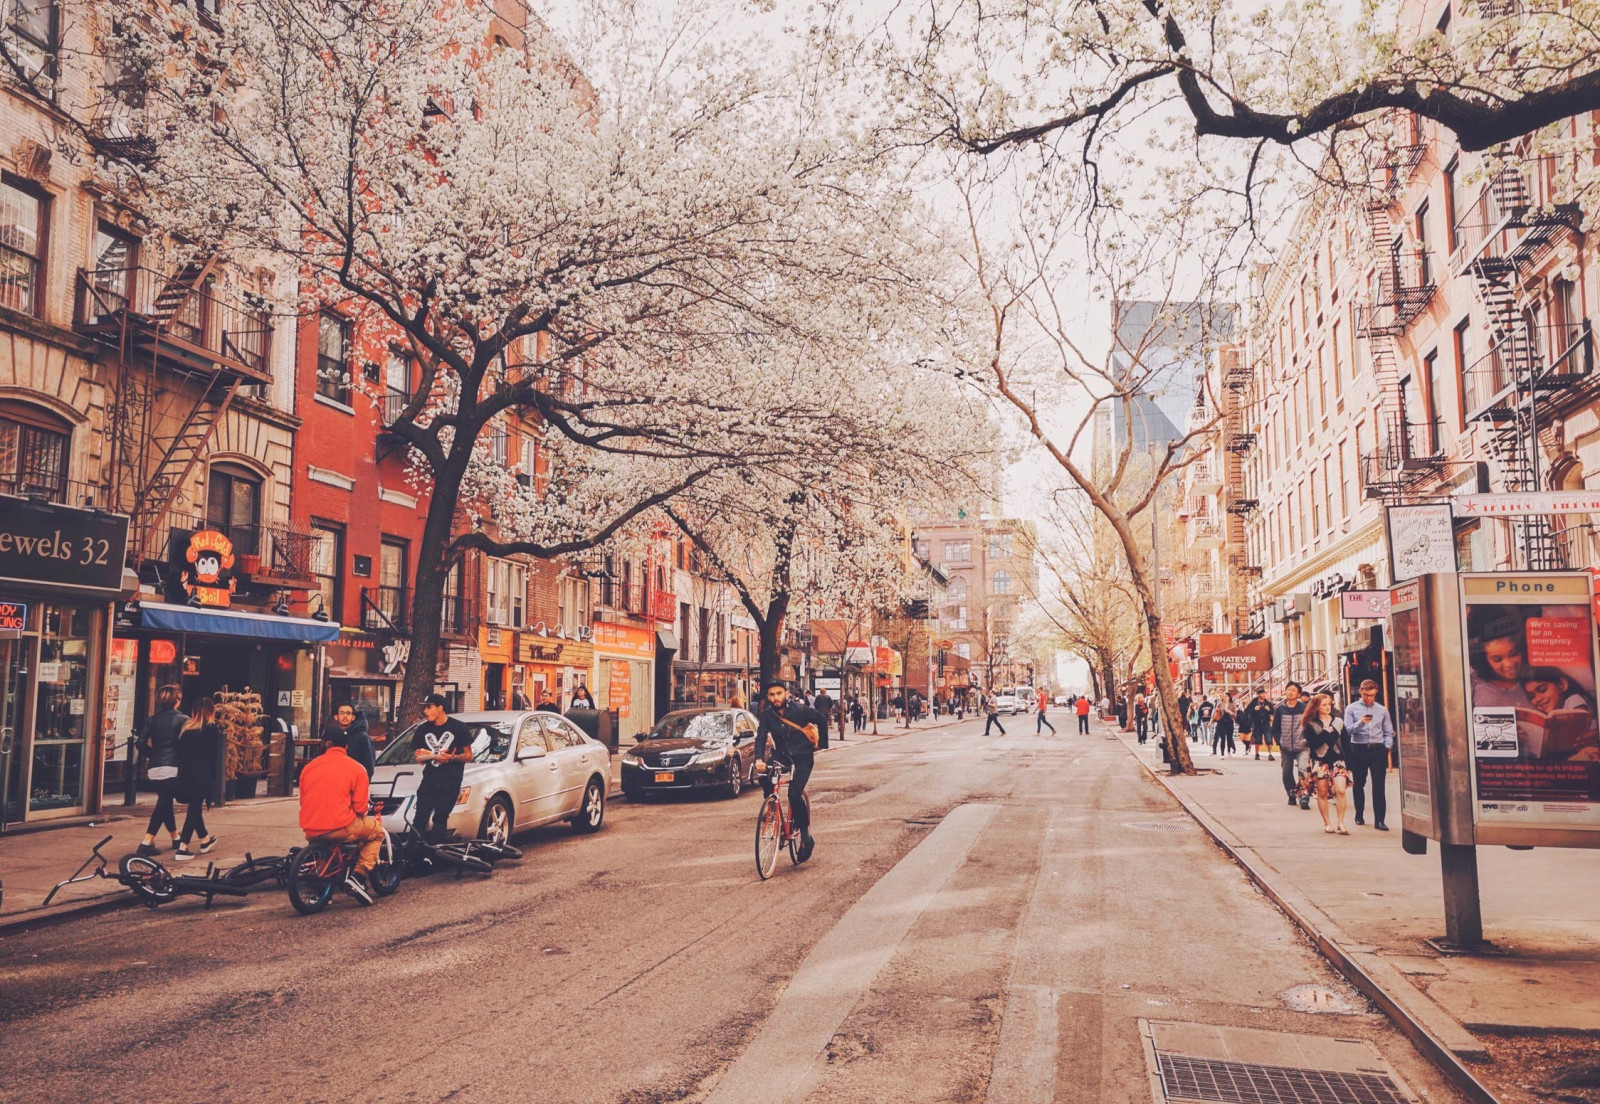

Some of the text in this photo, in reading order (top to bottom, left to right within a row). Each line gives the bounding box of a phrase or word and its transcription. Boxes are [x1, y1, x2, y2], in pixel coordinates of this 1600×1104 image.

[1480, 497, 1536, 512] TATTOO
[194, 531, 209, 549] Red
[214, 534, 231, 556] Gold
[80, 536, 110, 565] 32
[1496, 581, 1555, 592] Phone
[200, 587, 220, 604] Boil
[0, 603, 17, 616] DY
[1553, 621, 1578, 630] saving
[1531, 638, 1573, 646] emergency.
[1221, 662, 1248, 670] TATTOO
[280, 693, 288, 701] A
